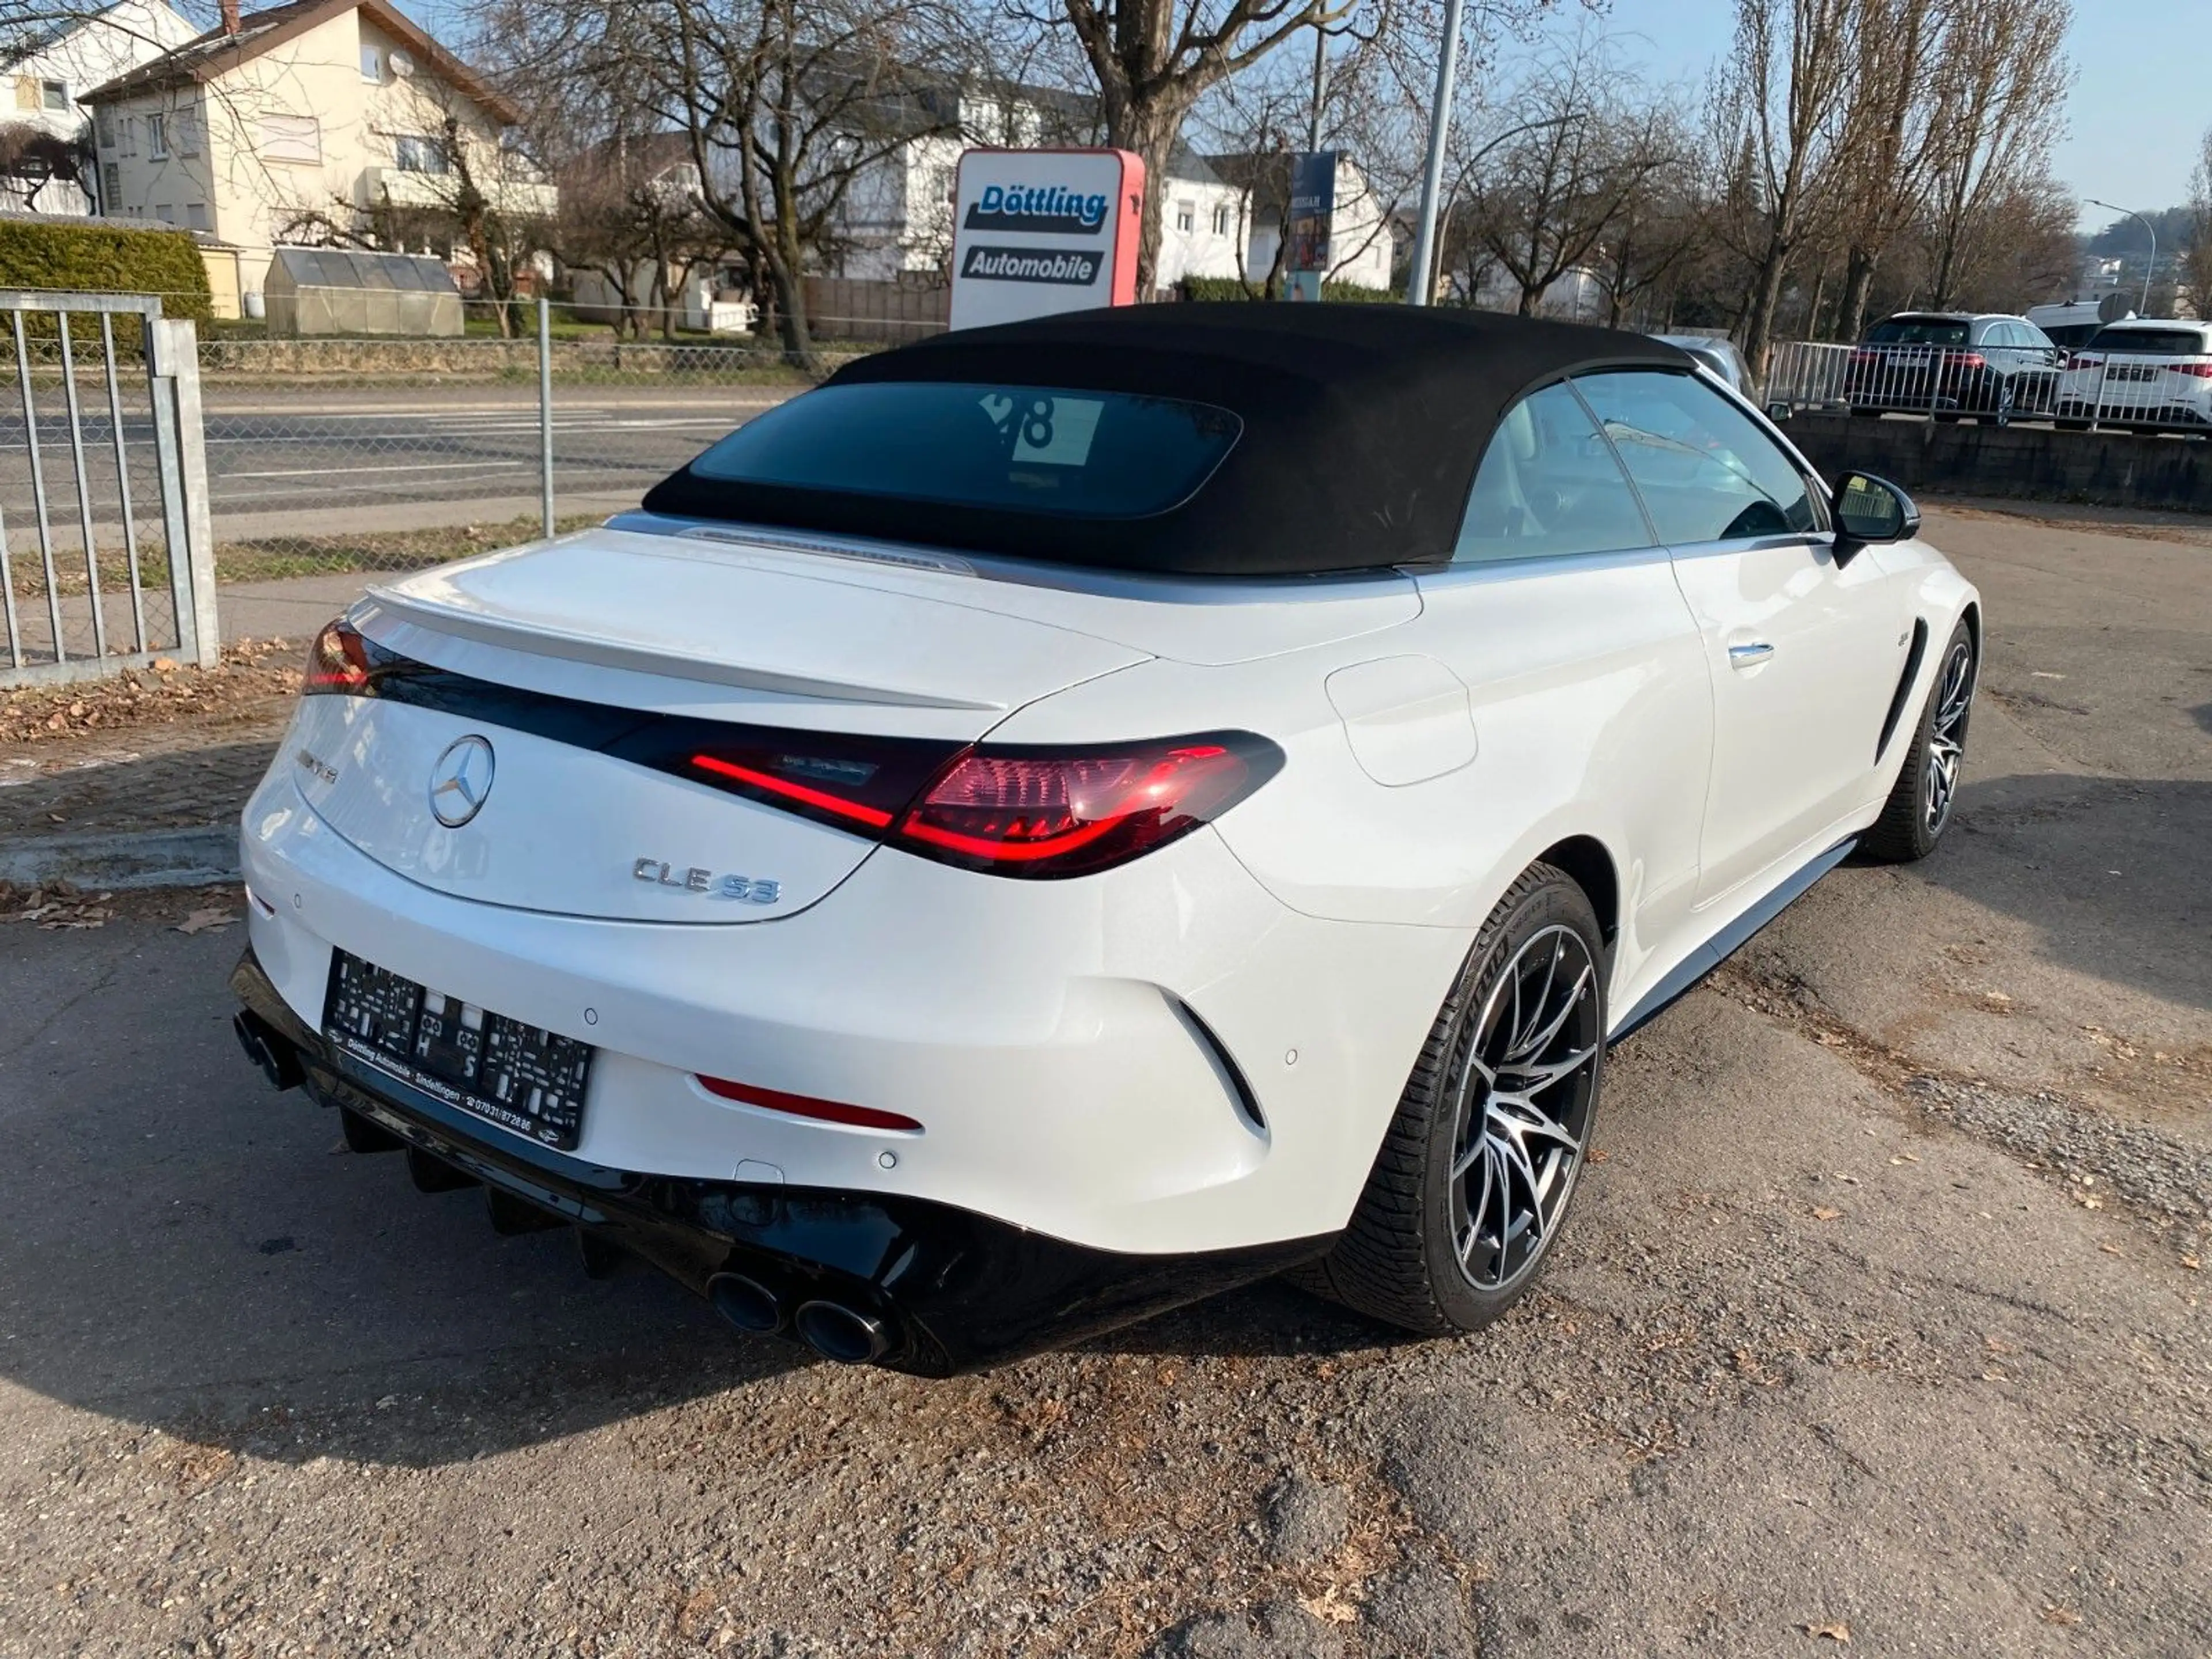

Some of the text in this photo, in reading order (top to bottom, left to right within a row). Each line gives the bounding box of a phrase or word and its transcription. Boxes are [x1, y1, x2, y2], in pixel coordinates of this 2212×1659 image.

[980, 185, 1106, 224] Döttling
[969, 251, 1093, 280] Automobile
[634, 857, 781, 903] CLE 53
[1449, 942, 1507, 1079] MICHELIN
[348, 1038, 375, 1061] Döttling
[376, 1053, 410, 1077] Automobile
